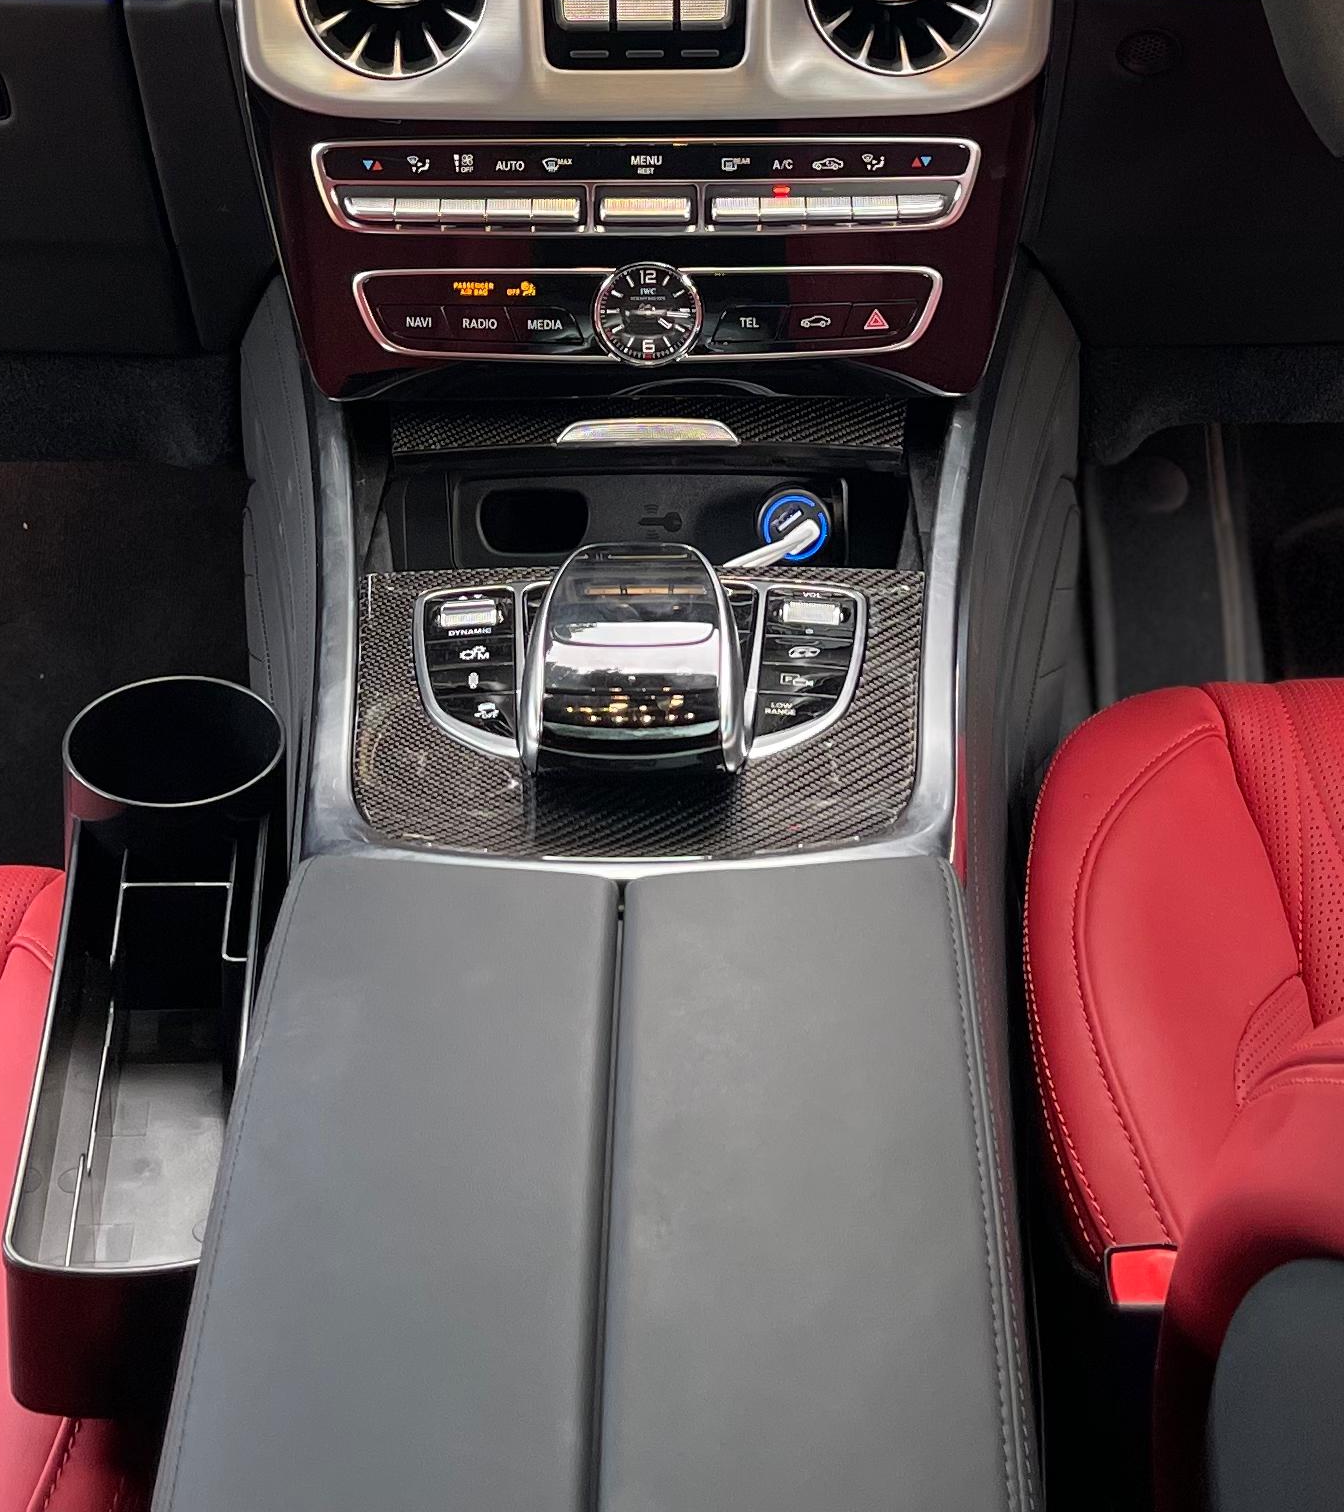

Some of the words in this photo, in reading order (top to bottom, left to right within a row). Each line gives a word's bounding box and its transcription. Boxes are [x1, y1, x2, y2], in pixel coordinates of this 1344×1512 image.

[495, 160, 525, 171] AUTO
[557, 157, 573, 165] MAX
[630, 155, 663, 166] MENU
[772, 159, 794, 170] A/C
[637, 167, 655, 175] REST
[639, 270, 656, 285] 12
[640, 287, 657, 295] IWC
[406, 316, 432, 328] NAVI
[462, 318, 498, 330] RADIO
[527, 319, 563, 330] MEDIA
[739, 316, 760, 328] TEL
[642, 339, 655, 353] 6
[448, 627, 492, 637] DYNAMIC
[770, 701, 793, 709] LOW
[764, 707, 796, 716] RANGE
